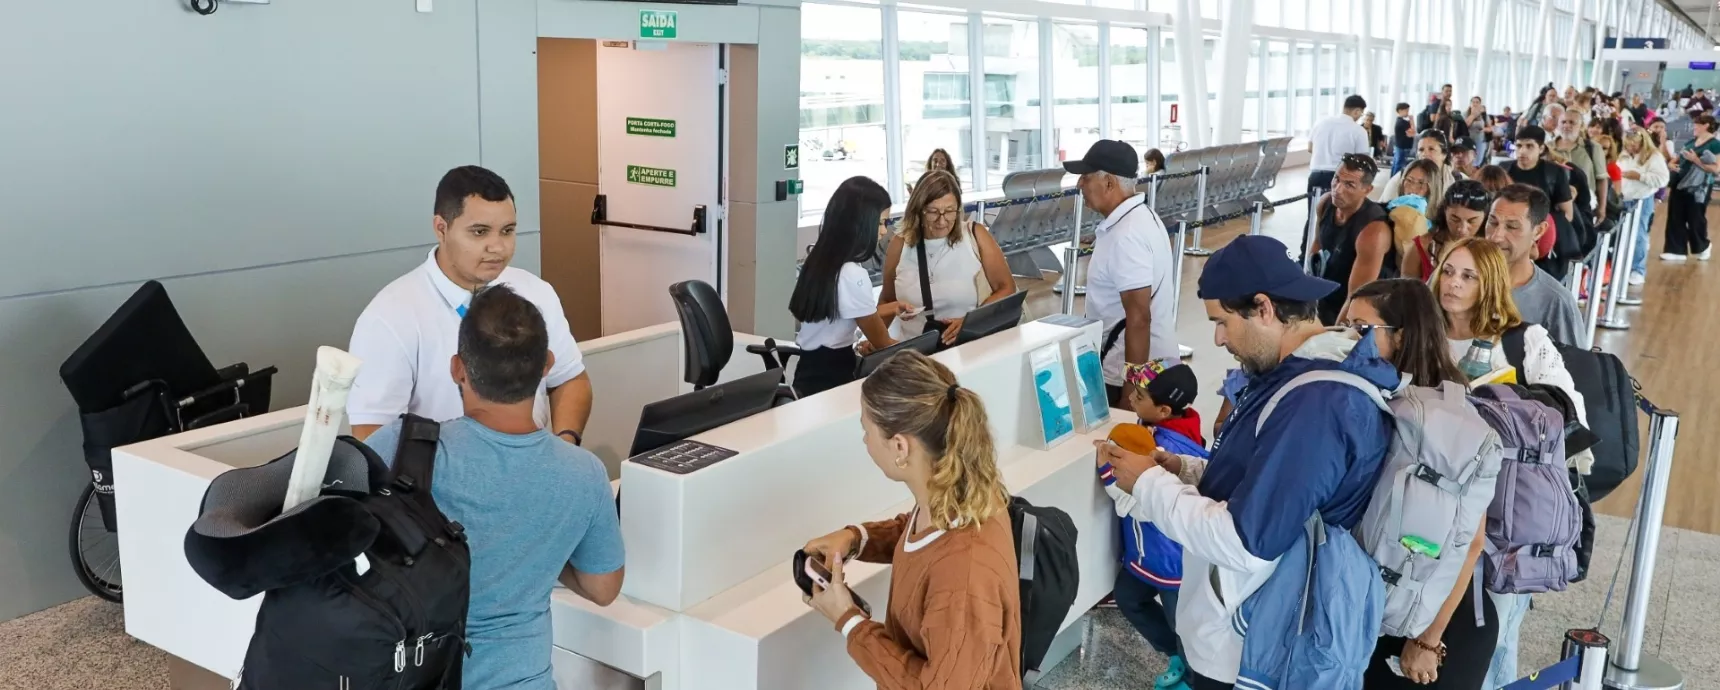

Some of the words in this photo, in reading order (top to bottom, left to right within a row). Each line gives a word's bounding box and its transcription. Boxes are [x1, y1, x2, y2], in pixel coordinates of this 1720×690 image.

[642, 12, 675, 28] SAÍDA
[641, 168, 668, 177] APERTE
[668, 170, 674, 178] E
[641, 175, 674, 185] EMPURRE
